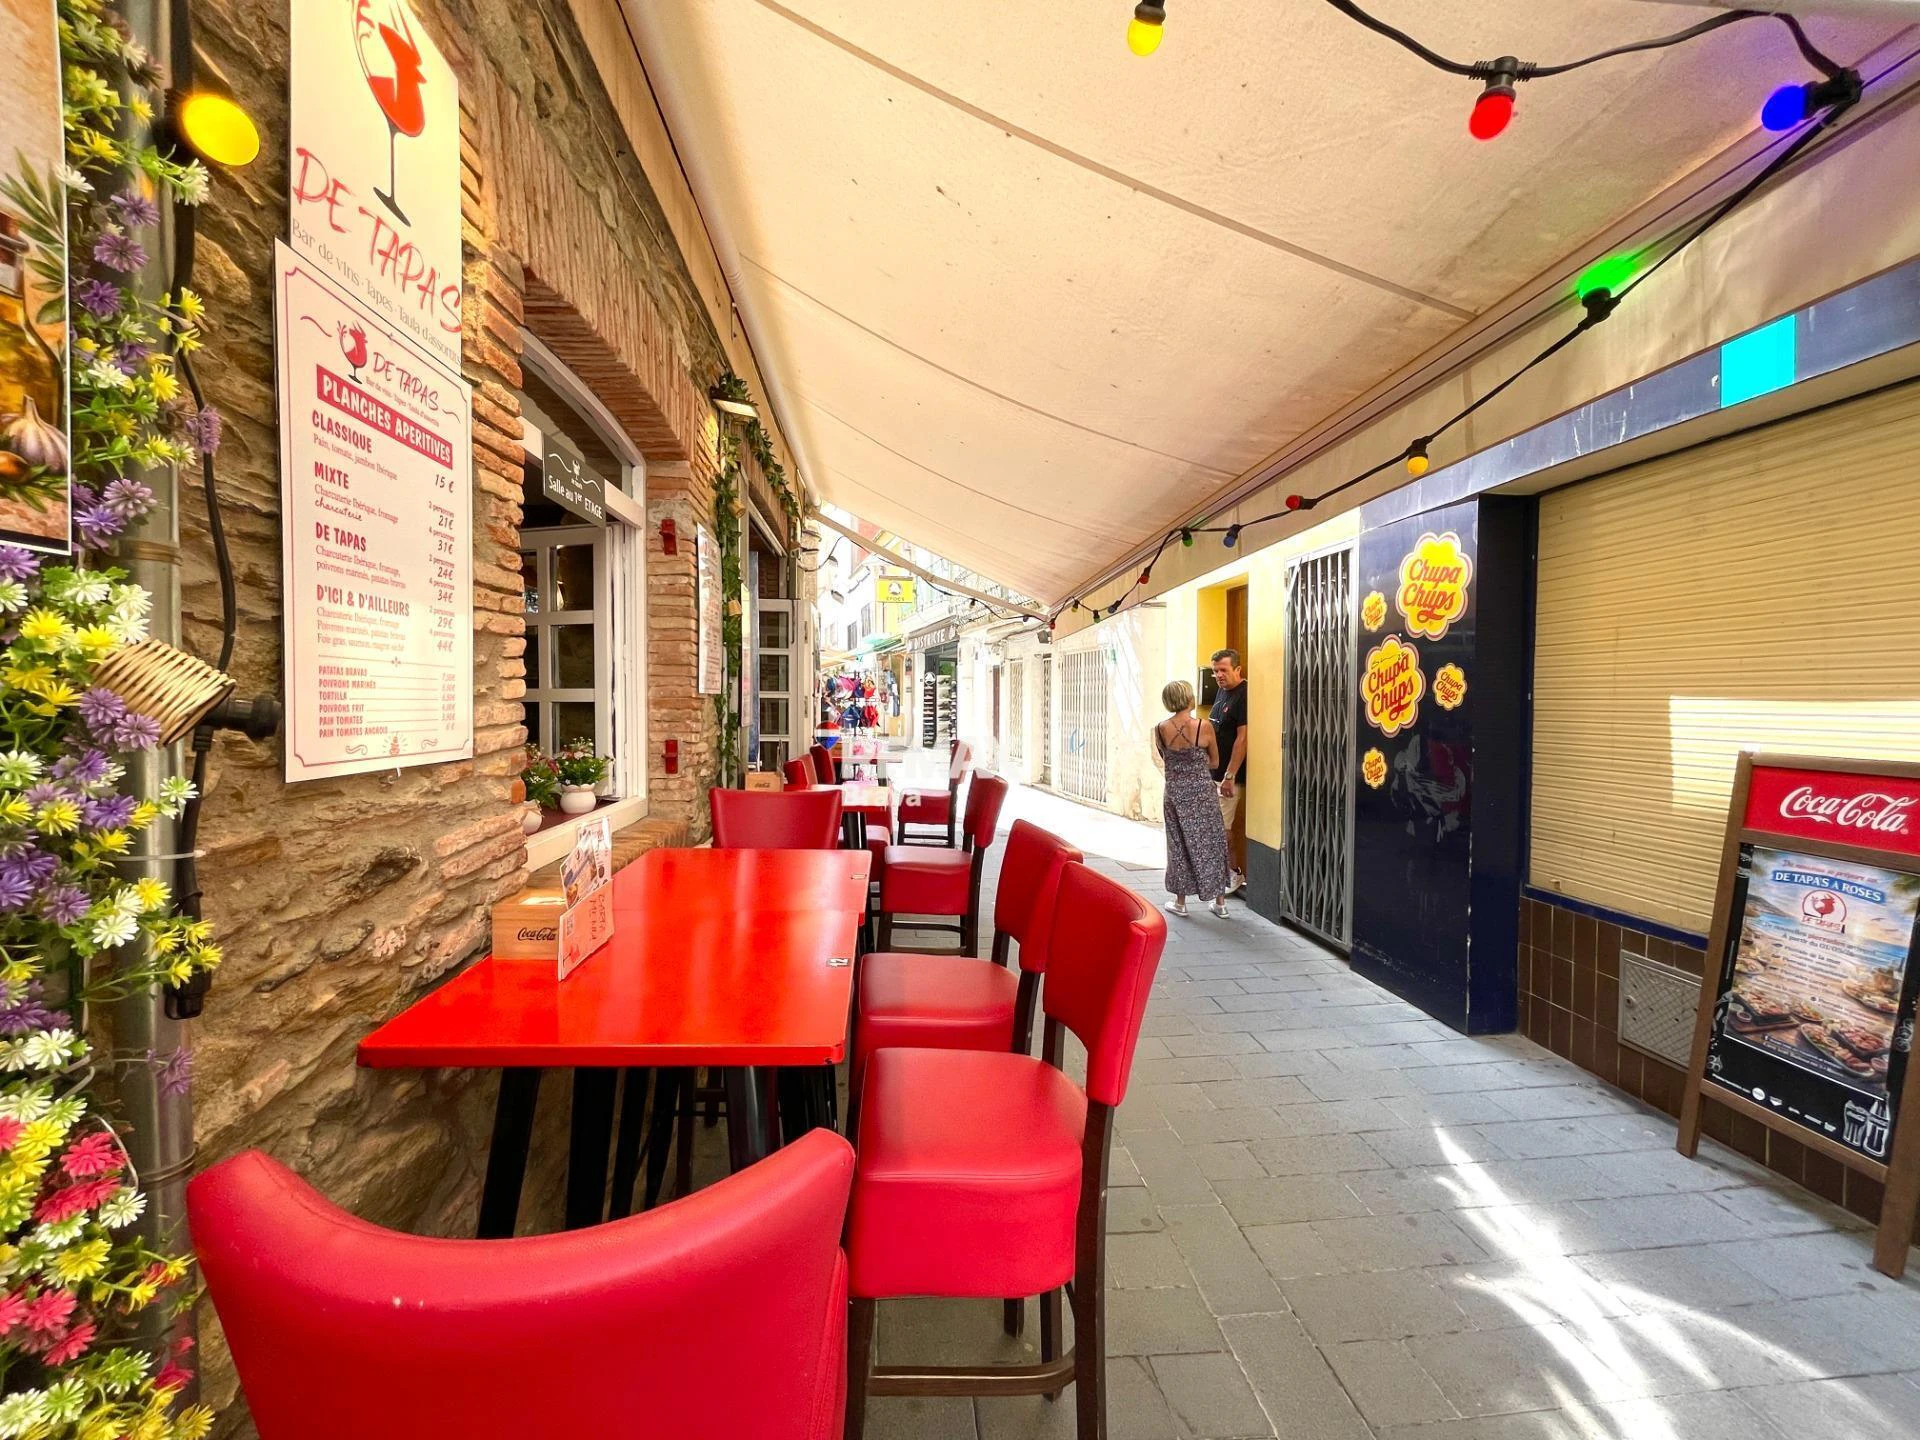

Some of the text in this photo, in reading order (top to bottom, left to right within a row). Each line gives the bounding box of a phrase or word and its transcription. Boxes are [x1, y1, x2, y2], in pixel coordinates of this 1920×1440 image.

[293, 147, 355, 234] DE
[292, 218, 316, 248] Bar
[318, 243, 334, 265] de
[336, 257, 360, 287] vins
[366, 278, 393, 312] Tapes
[398, 305, 420, 335] Taula
[373, 351, 395, 382] DE
[322, 373, 391, 431] PLANCHES
[312, 409, 372, 454] CLASSIQUE
[314, 461, 349, 489] MIXTE
[435, 474, 454, 493] 15 €
[548, 474, 565, 496] Salle
[565, 488, 574, 502] au
[584, 497, 602, 519] ETAGE
[438, 515, 453, 530] 21€
[315, 522, 367, 552] DE TAPAS
[438, 540, 453, 554] 31€
[437, 566, 453, 580] 24€
[1410, 559, 1462, 589] Chupa
[317, 584, 410, 617] D'ICI & D'AILLEURS
[437, 589, 453, 604] 34€
[1403, 583, 1456, 623] Chups
[437, 616, 453, 630] 29€
[319, 665, 368, 677] PATATAS BRAVAS
[1368, 654, 1410, 693] Chupa
[1440, 671, 1463, 691] Chupa
[319, 679, 349, 689] POIVRONS
[319, 691, 347, 701] TORTILLA
[1436, 681, 1458, 703] Chups
[319, 704, 349, 713] POIVRONS
[1371, 675, 1414, 721] Chups
[319, 716, 363, 726] PAIN TOMATES
[319, 728, 334, 738] PAIN
[336, 727, 363, 737] TOMATES
[1780, 786, 1919, 832] Coca-Cola
[1775, 872, 1790, 881] DE
[1842, 882, 1881, 901] ROSES
[517, 927, 559, 941] Coca-Cola
